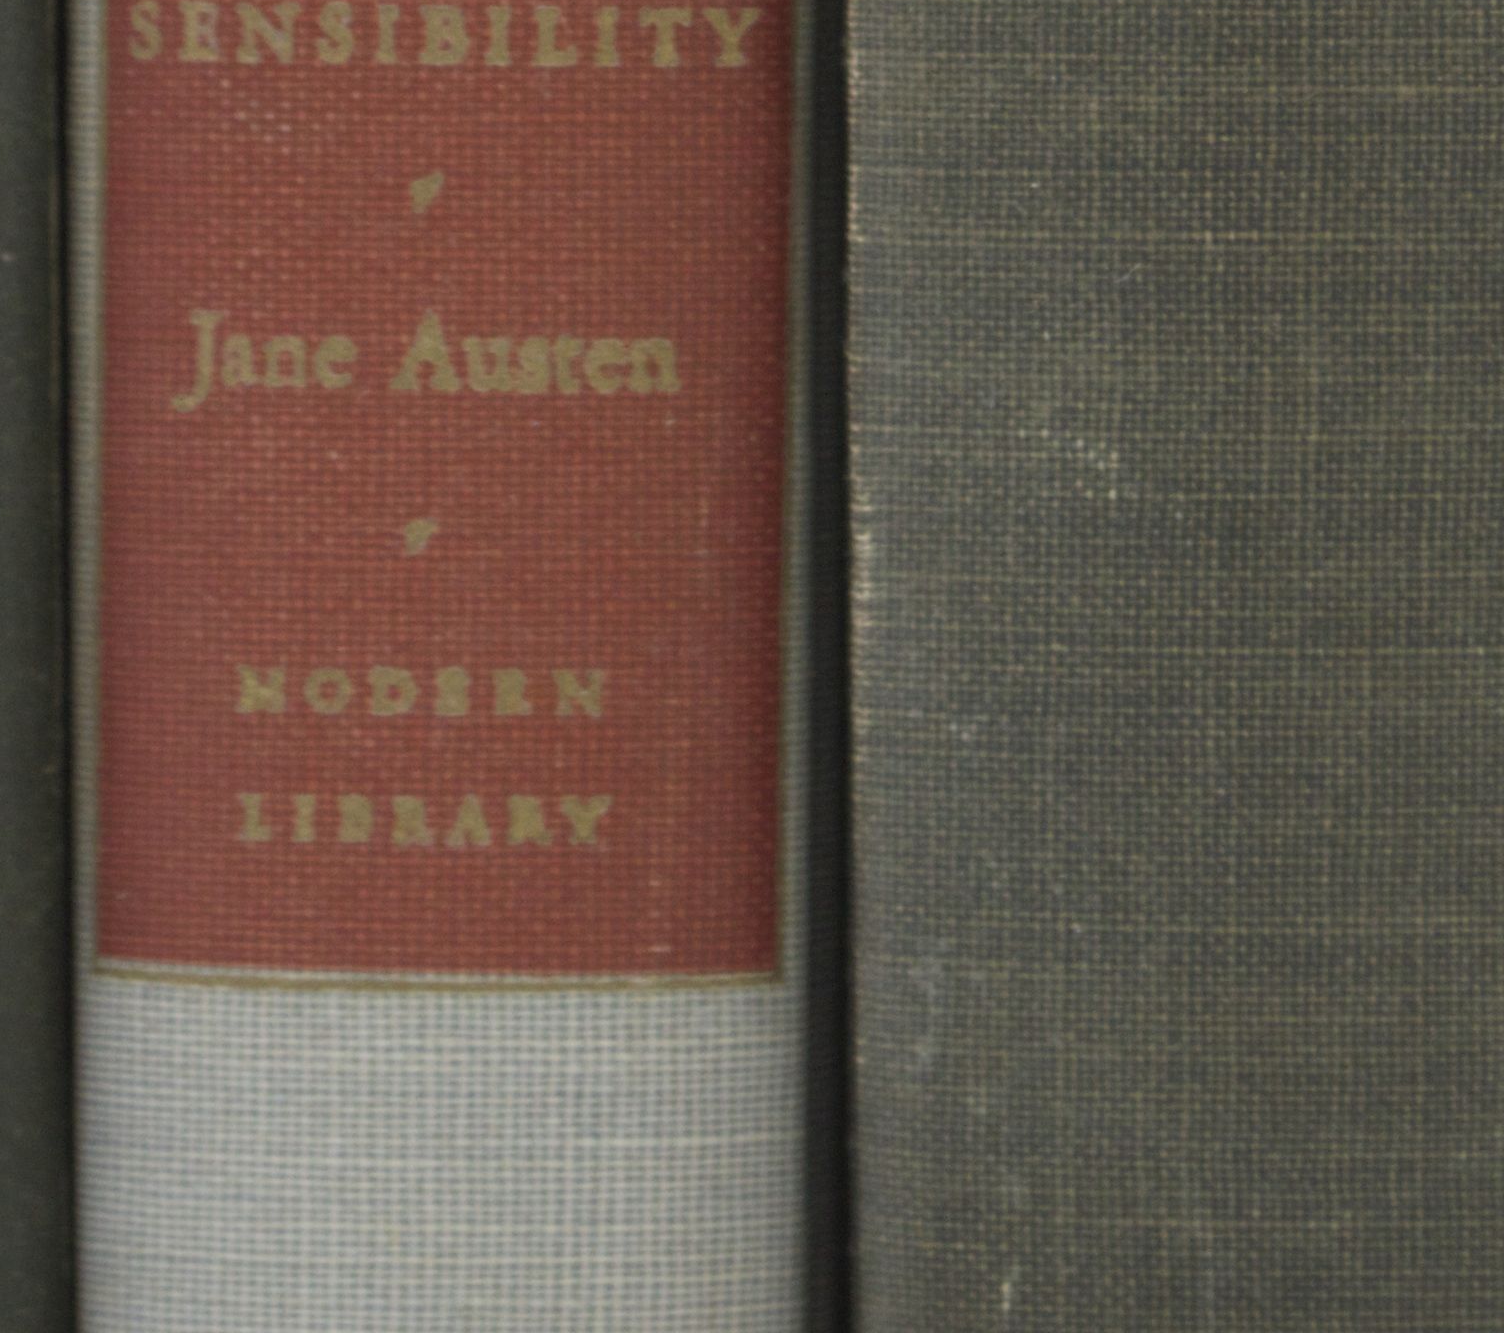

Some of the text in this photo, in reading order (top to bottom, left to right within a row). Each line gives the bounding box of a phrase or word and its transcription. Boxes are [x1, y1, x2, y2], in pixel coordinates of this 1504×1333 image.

[129, 0, 763, 69] SENSIBILITY
[171, 309, 682, 413] Jane Austen
[236, 665, 606, 718] MODERN
[237, 792, 613, 847] LIBRARY
